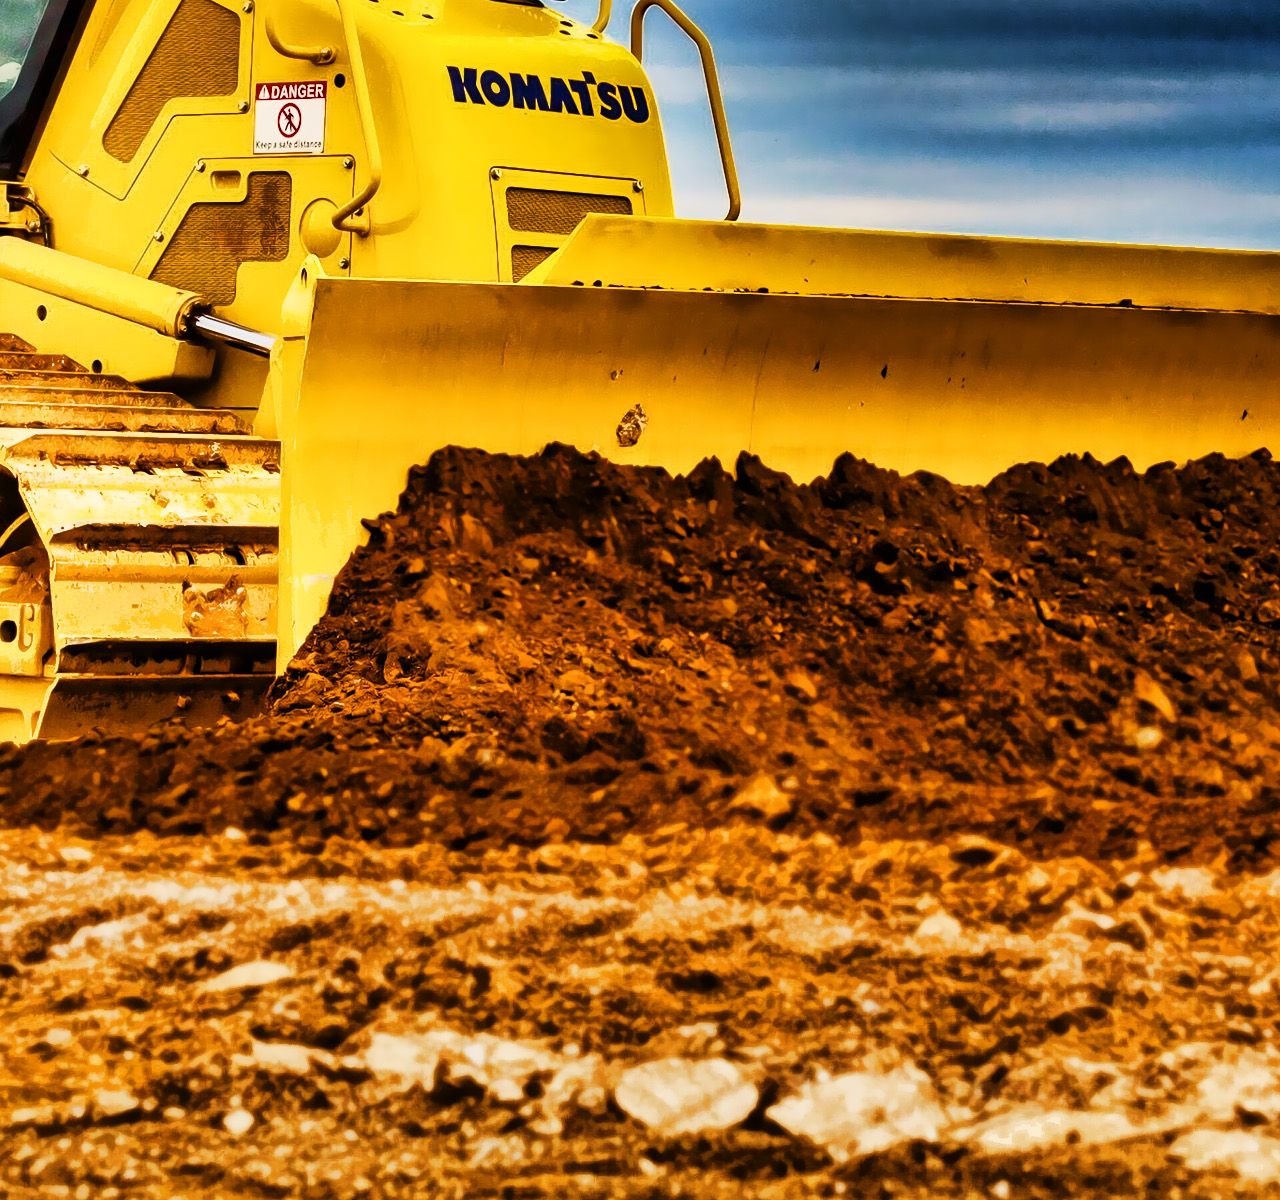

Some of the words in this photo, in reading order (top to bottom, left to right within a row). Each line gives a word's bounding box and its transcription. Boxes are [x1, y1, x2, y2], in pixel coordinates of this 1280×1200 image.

[271, 83, 324, 99] DANGER
[446, 65, 650, 124] KOMATSU
[255, 141, 272, 150] Keep
[279, 141, 293, 149] safe
[293, 140, 322, 148] distance
